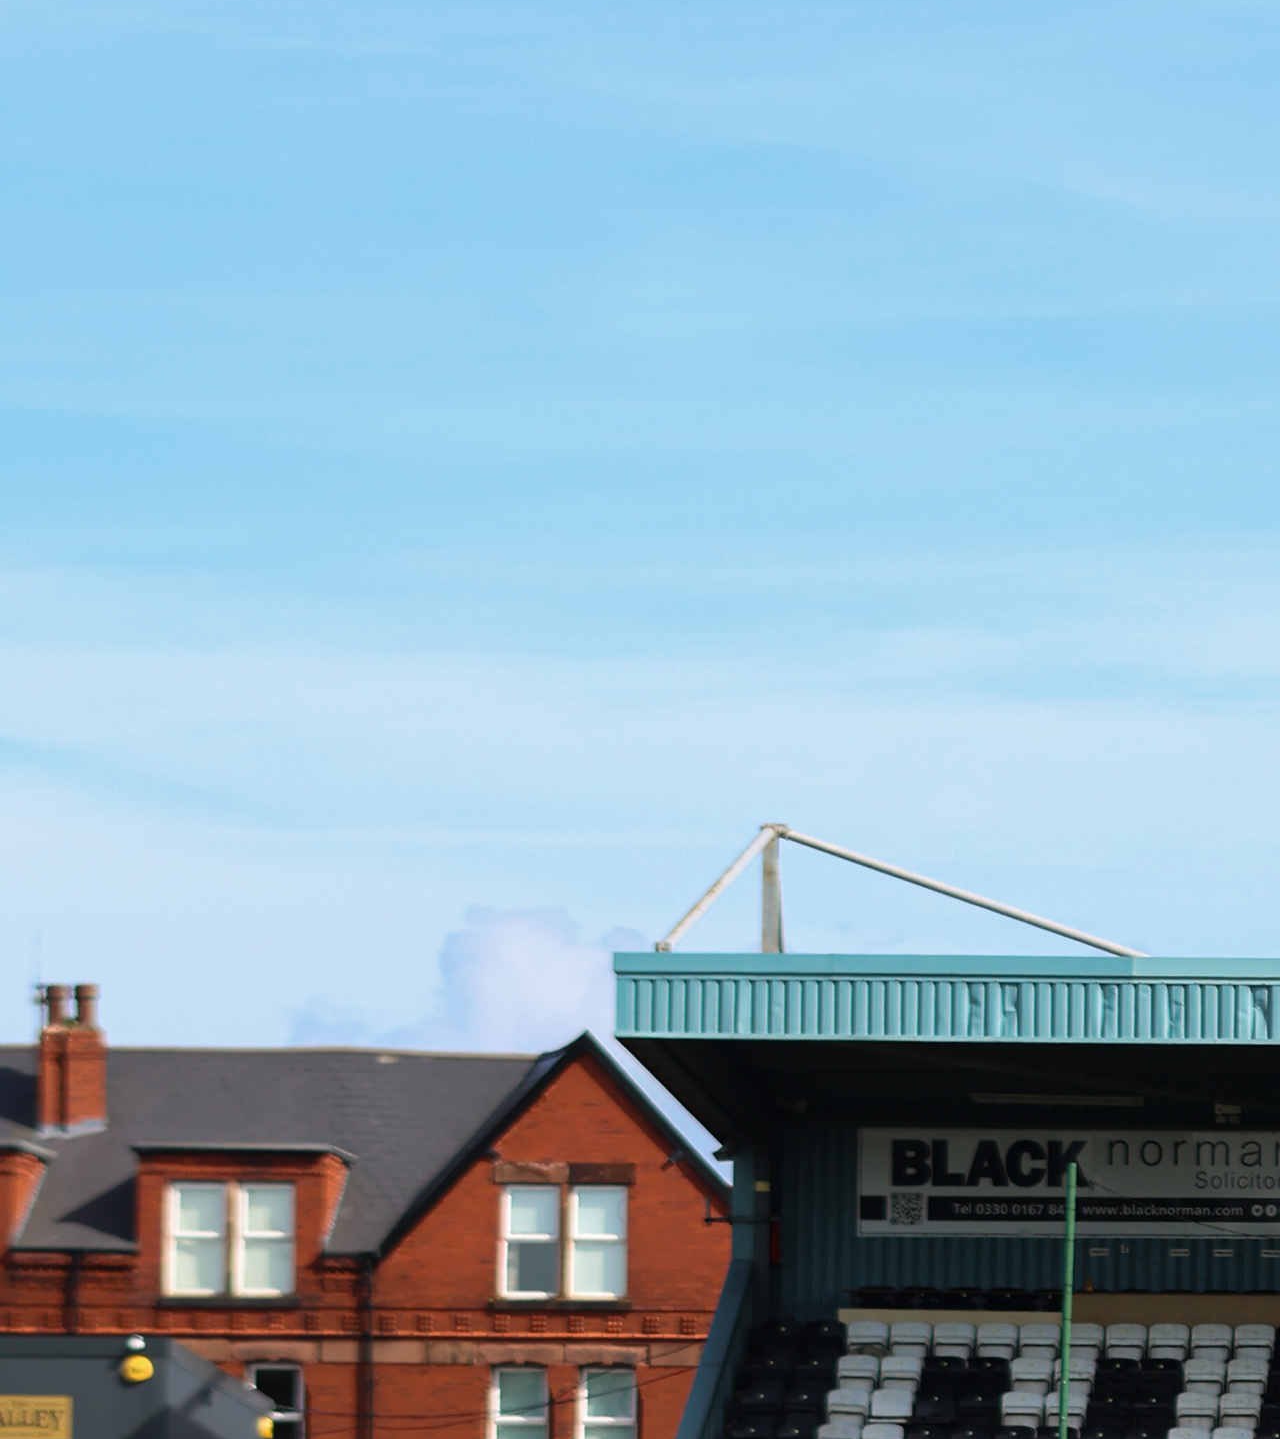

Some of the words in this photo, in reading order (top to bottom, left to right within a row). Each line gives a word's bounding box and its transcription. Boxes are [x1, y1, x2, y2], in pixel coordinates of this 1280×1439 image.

[892, 1139, 1089, 1188] BLACK
[953, 1203, 973, 1216] Tel
[976, 1203, 1010, 1216] 0330
[1012, 1204, 1043, 1216] 0167
[1083, 1204, 1244, 1217] www.blacknorman.com
